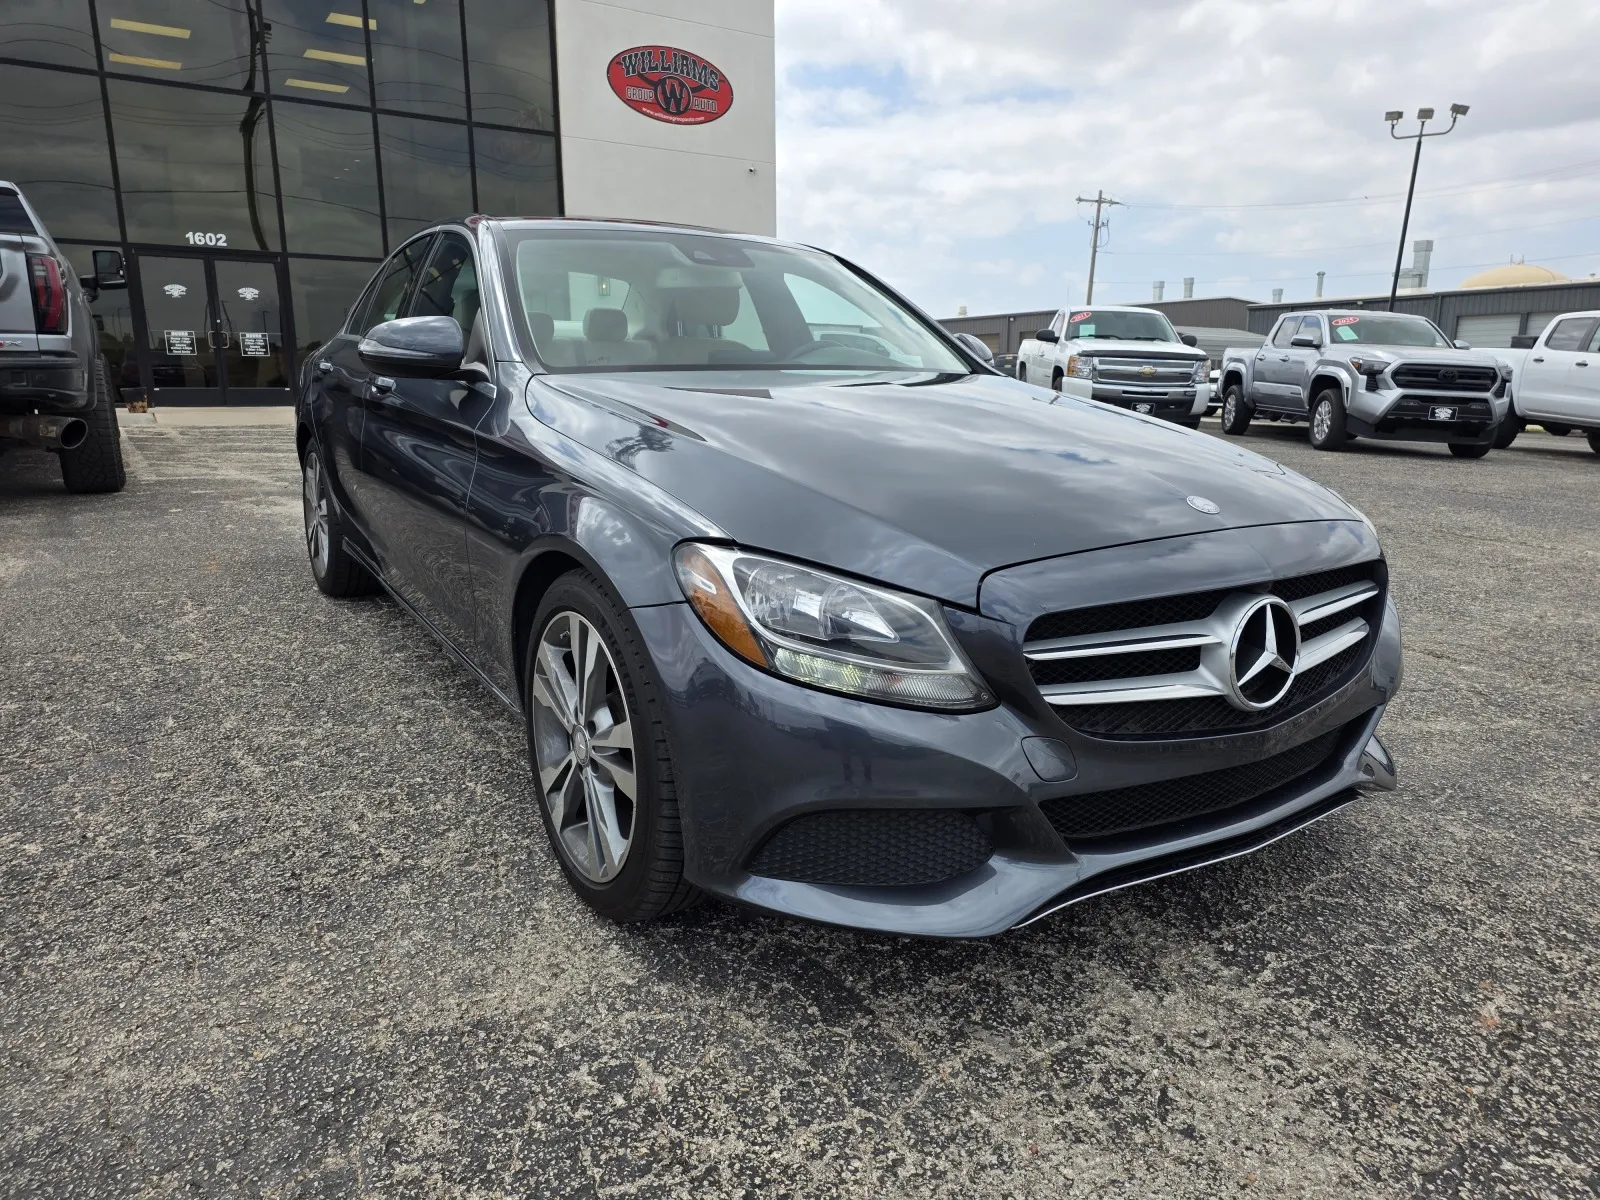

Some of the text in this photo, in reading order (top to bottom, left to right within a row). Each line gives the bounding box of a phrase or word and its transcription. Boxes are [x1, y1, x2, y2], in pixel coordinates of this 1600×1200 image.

[622, 50, 720, 92] WILLIAMS
[626, 78, 718, 114] GROUP W AUTO
[185, 232, 227, 246] 1602
